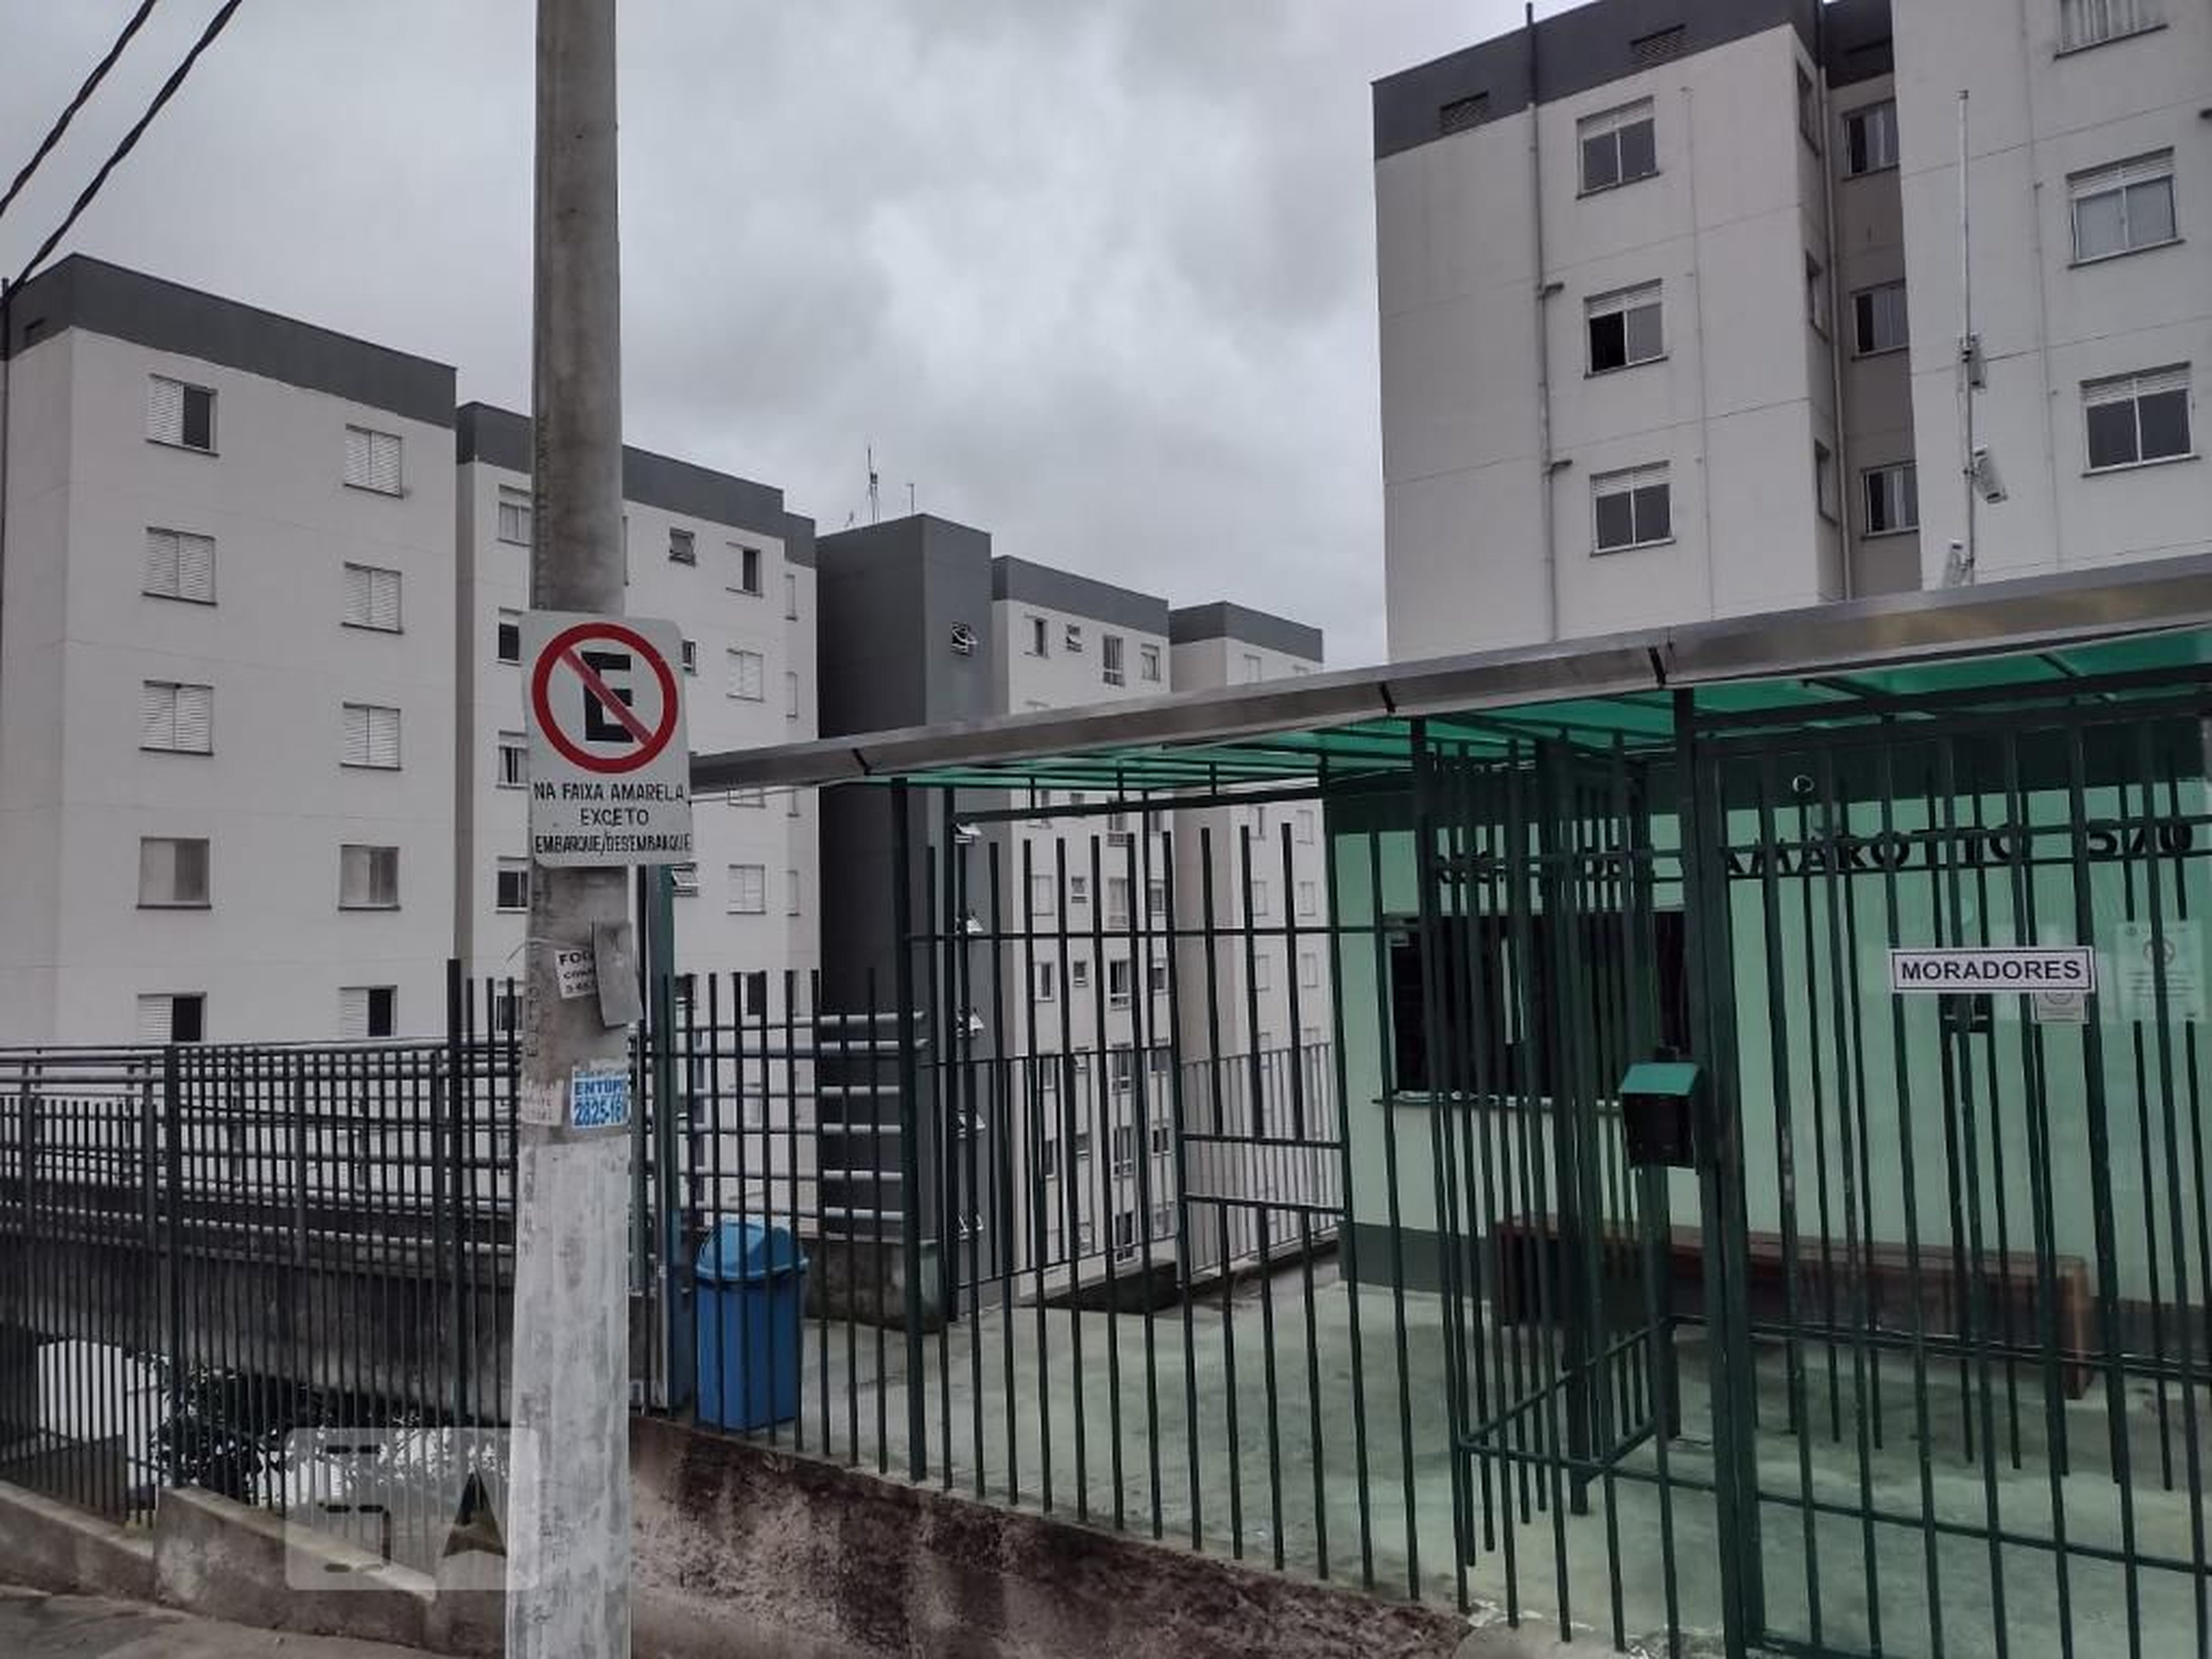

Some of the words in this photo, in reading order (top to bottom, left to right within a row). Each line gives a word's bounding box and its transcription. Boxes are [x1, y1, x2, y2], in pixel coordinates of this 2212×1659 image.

[533, 782, 556, 801] NA
[562, 782, 604, 800] FAIXA
[609, 782, 684, 801] AMARELA
[580, 808, 649, 827] EXCETO
[1902, 960, 2081, 980] MORADORES
